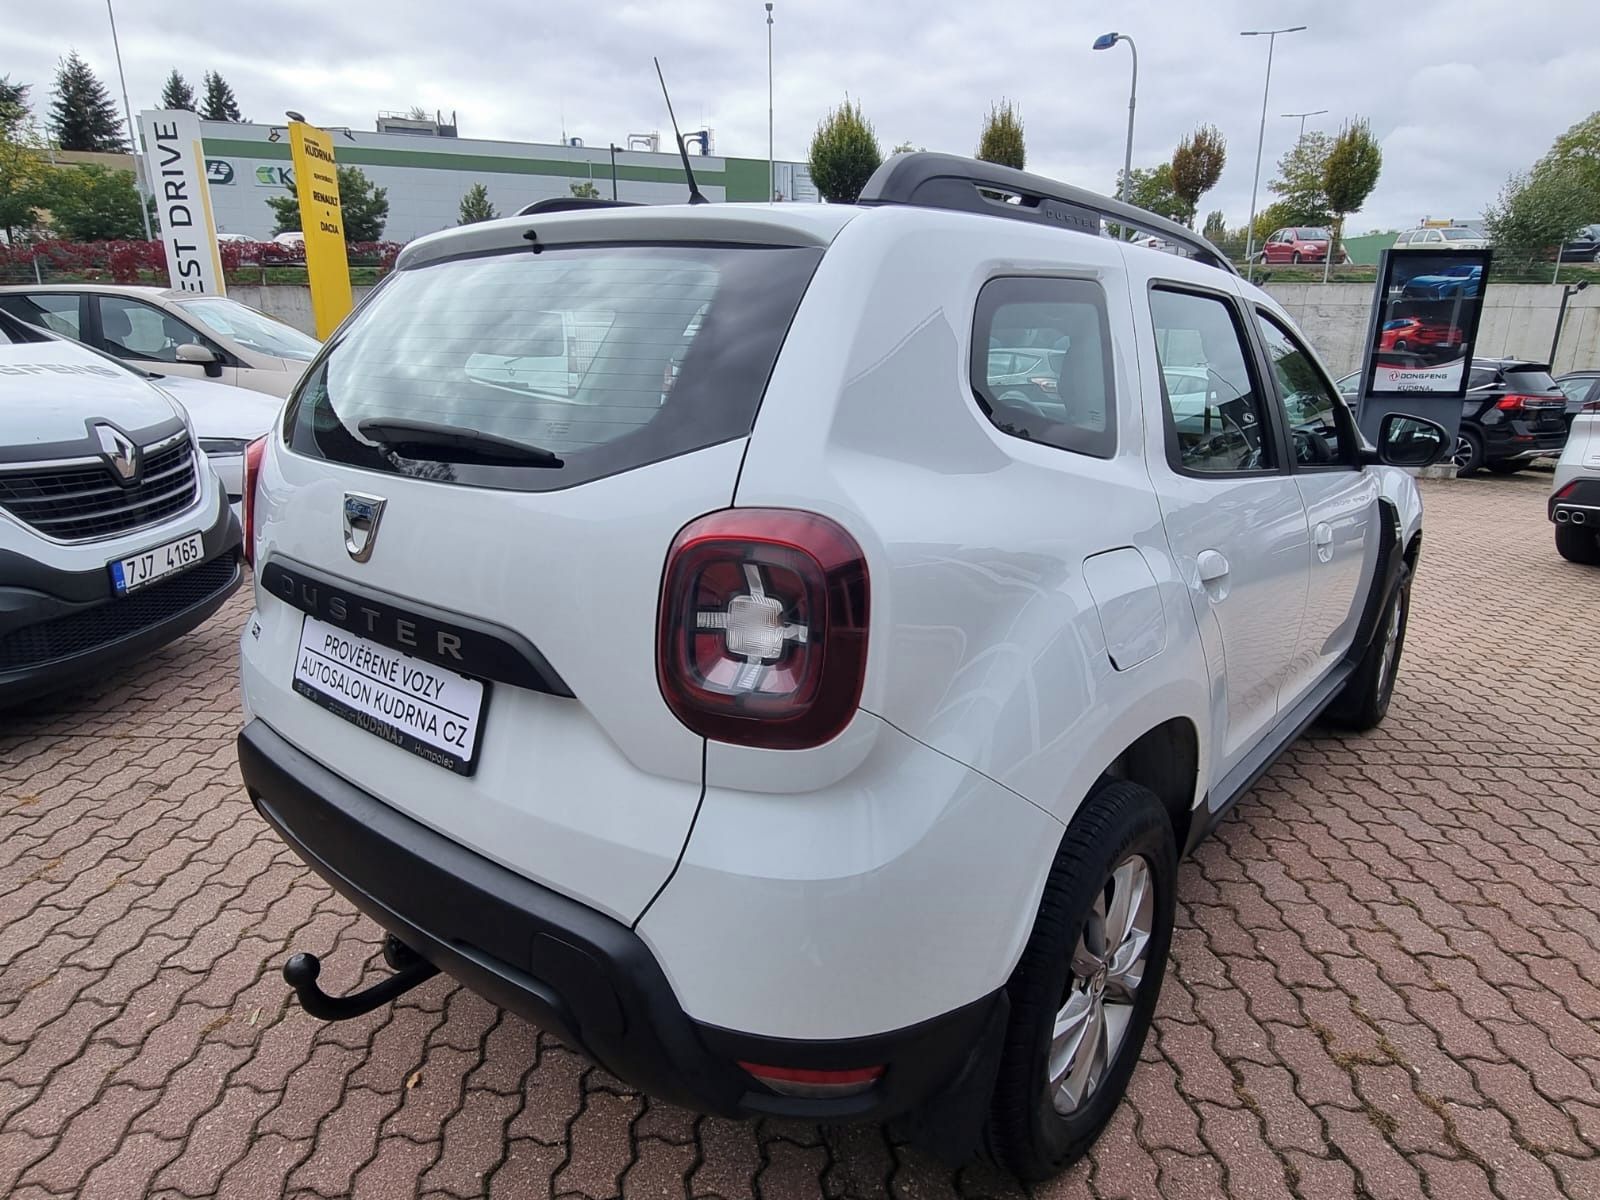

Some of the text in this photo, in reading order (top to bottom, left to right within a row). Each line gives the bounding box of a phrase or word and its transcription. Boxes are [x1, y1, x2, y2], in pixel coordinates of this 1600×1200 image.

[154, 121, 192, 228] DRIVE
[304, 143, 333, 163] KUDRNA
[313, 190, 338, 207] RENAULT
[320, 221, 339, 234] DACIA
[126, 554, 154, 585] 7J7
[166, 538, 198, 568] 4165
[280, 574, 464, 661] DUSTER
[323, 633, 445, 700] PROVĚŘENÉ VOZY
[301, 655, 371, 703] AUTOSALON
[373, 692, 438, 737] KUDRNA
[442, 720, 468, 749] CZ
[355, 710, 398, 744] KUDRNA
